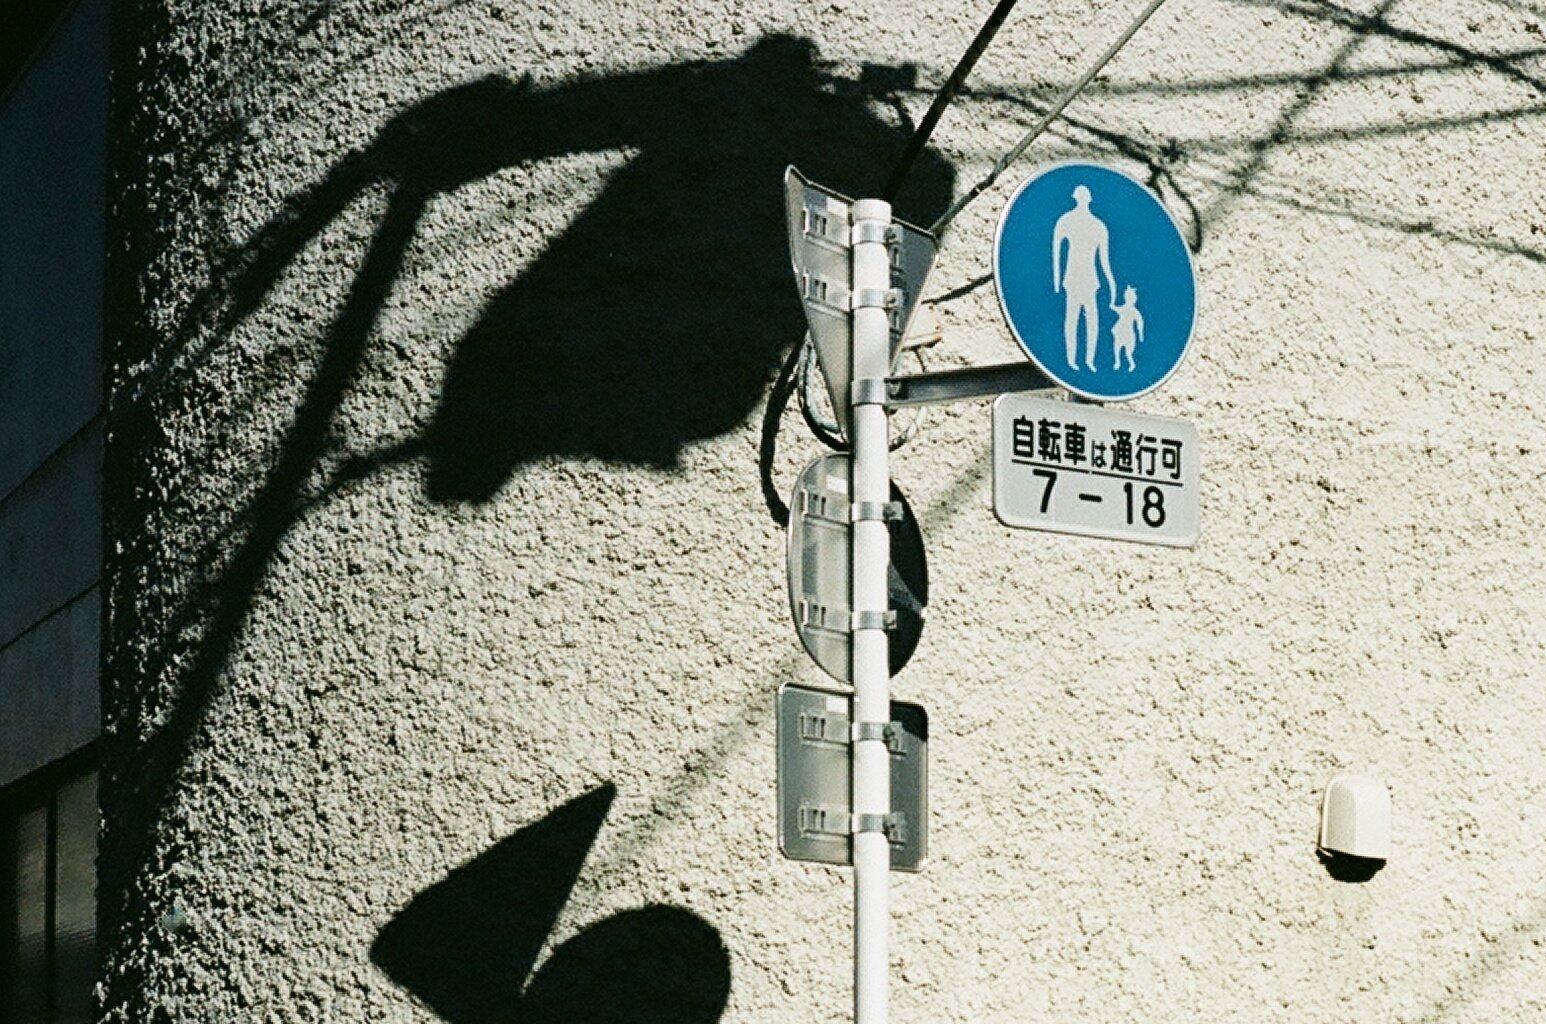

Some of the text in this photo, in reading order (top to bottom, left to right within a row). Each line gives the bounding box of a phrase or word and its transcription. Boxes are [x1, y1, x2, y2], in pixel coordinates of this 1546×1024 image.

[1011, 415, 1184, 480] 自転車は通行可
[1032, 468, 1058, 514] 7
[1123, 481, 1167, 528] 18
